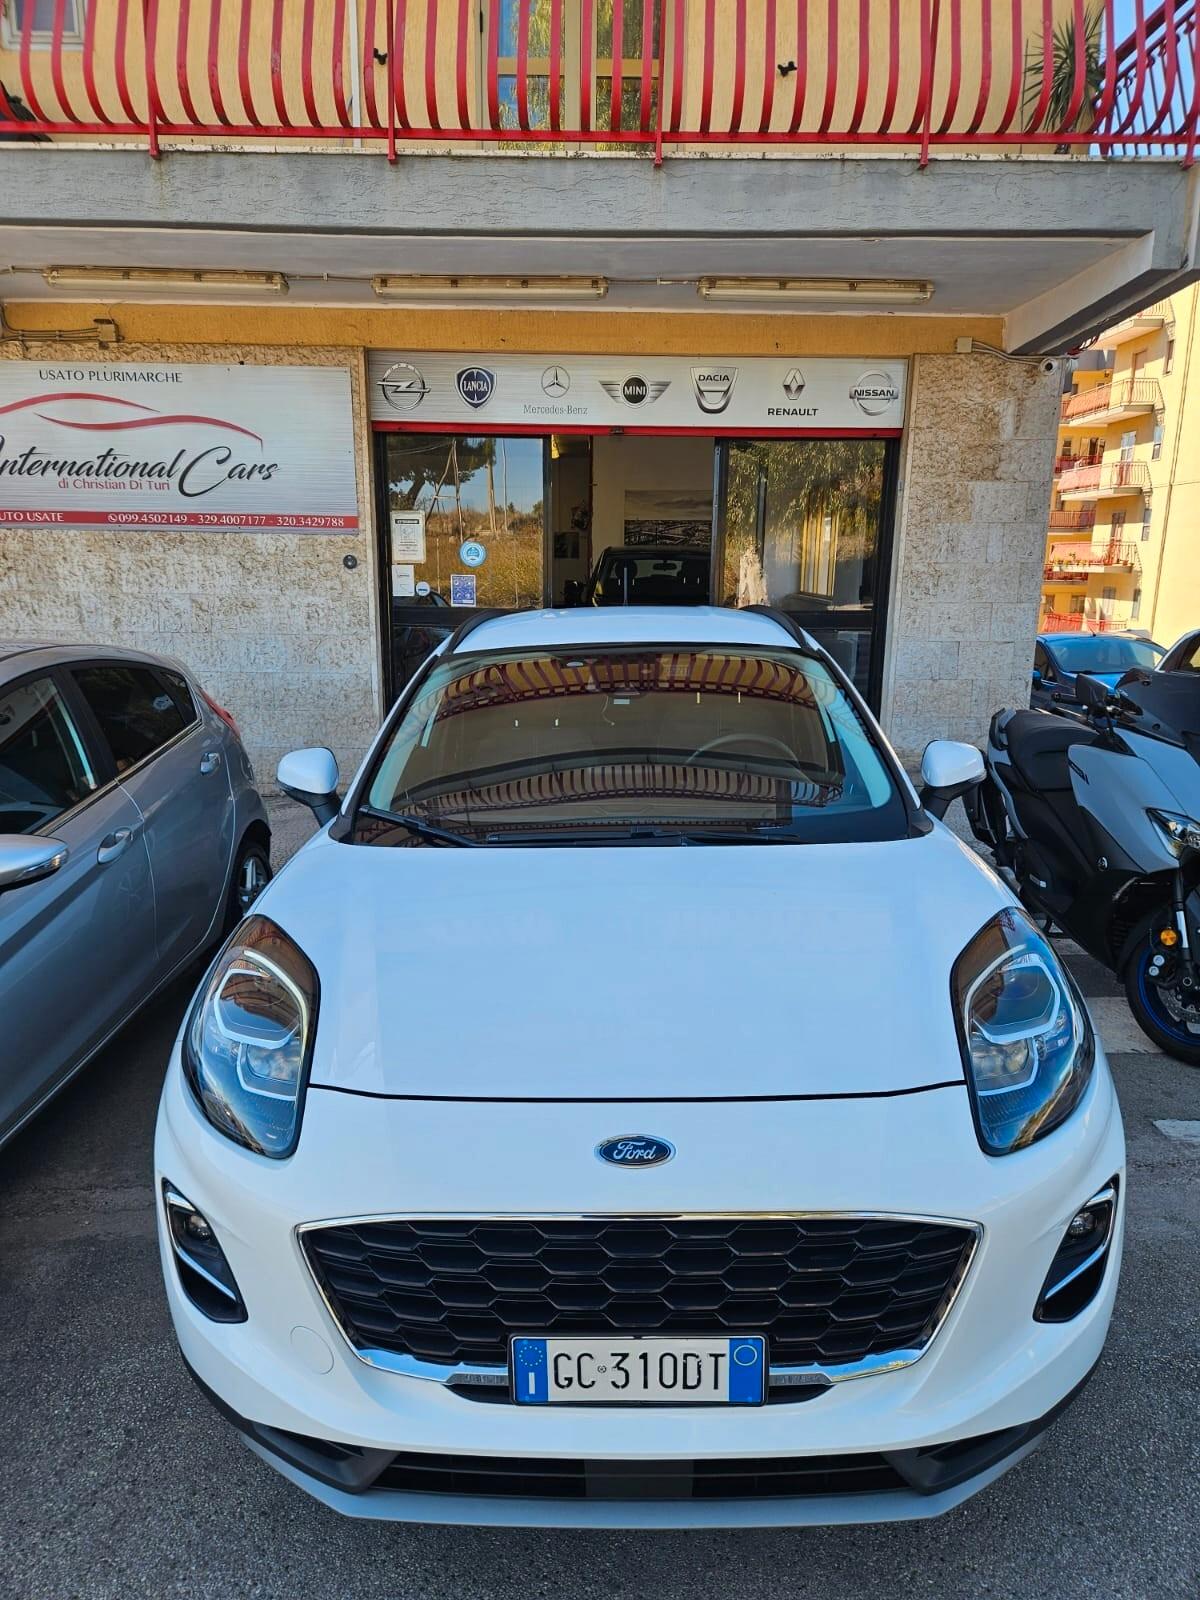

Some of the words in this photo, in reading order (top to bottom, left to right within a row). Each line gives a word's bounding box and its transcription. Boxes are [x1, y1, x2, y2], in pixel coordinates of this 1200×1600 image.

[39, 370, 84, 381] USATO
[88, 371, 183, 383] PLURIMARCHE
[698, 374, 730, 382] DACIA
[463, 380, 489, 391] LANCIA
[624, 385, 646, 396] MINI
[854, 389, 894, 397] NISSAN
[523, 404, 588, 415] Mercedes-Benz
[768, 407, 819, 417] RENAULT
[0, 434, 187, 479] nternational
[178, 446, 280, 497] Cars
[58, 479, 69, 489] di
[73, 479, 126, 490] Christian
[130, 480, 143, 490] Di
[146, 480, 170, 490] Turi
[27, 512, 64, 522] USATE
[118, 514, 188, 524] 099.4502149
[198, 515, 266, 525] 329.4007177
[276, 517, 344, 527] 320.3429788
[613, 1141, 656, 1160] Ford
